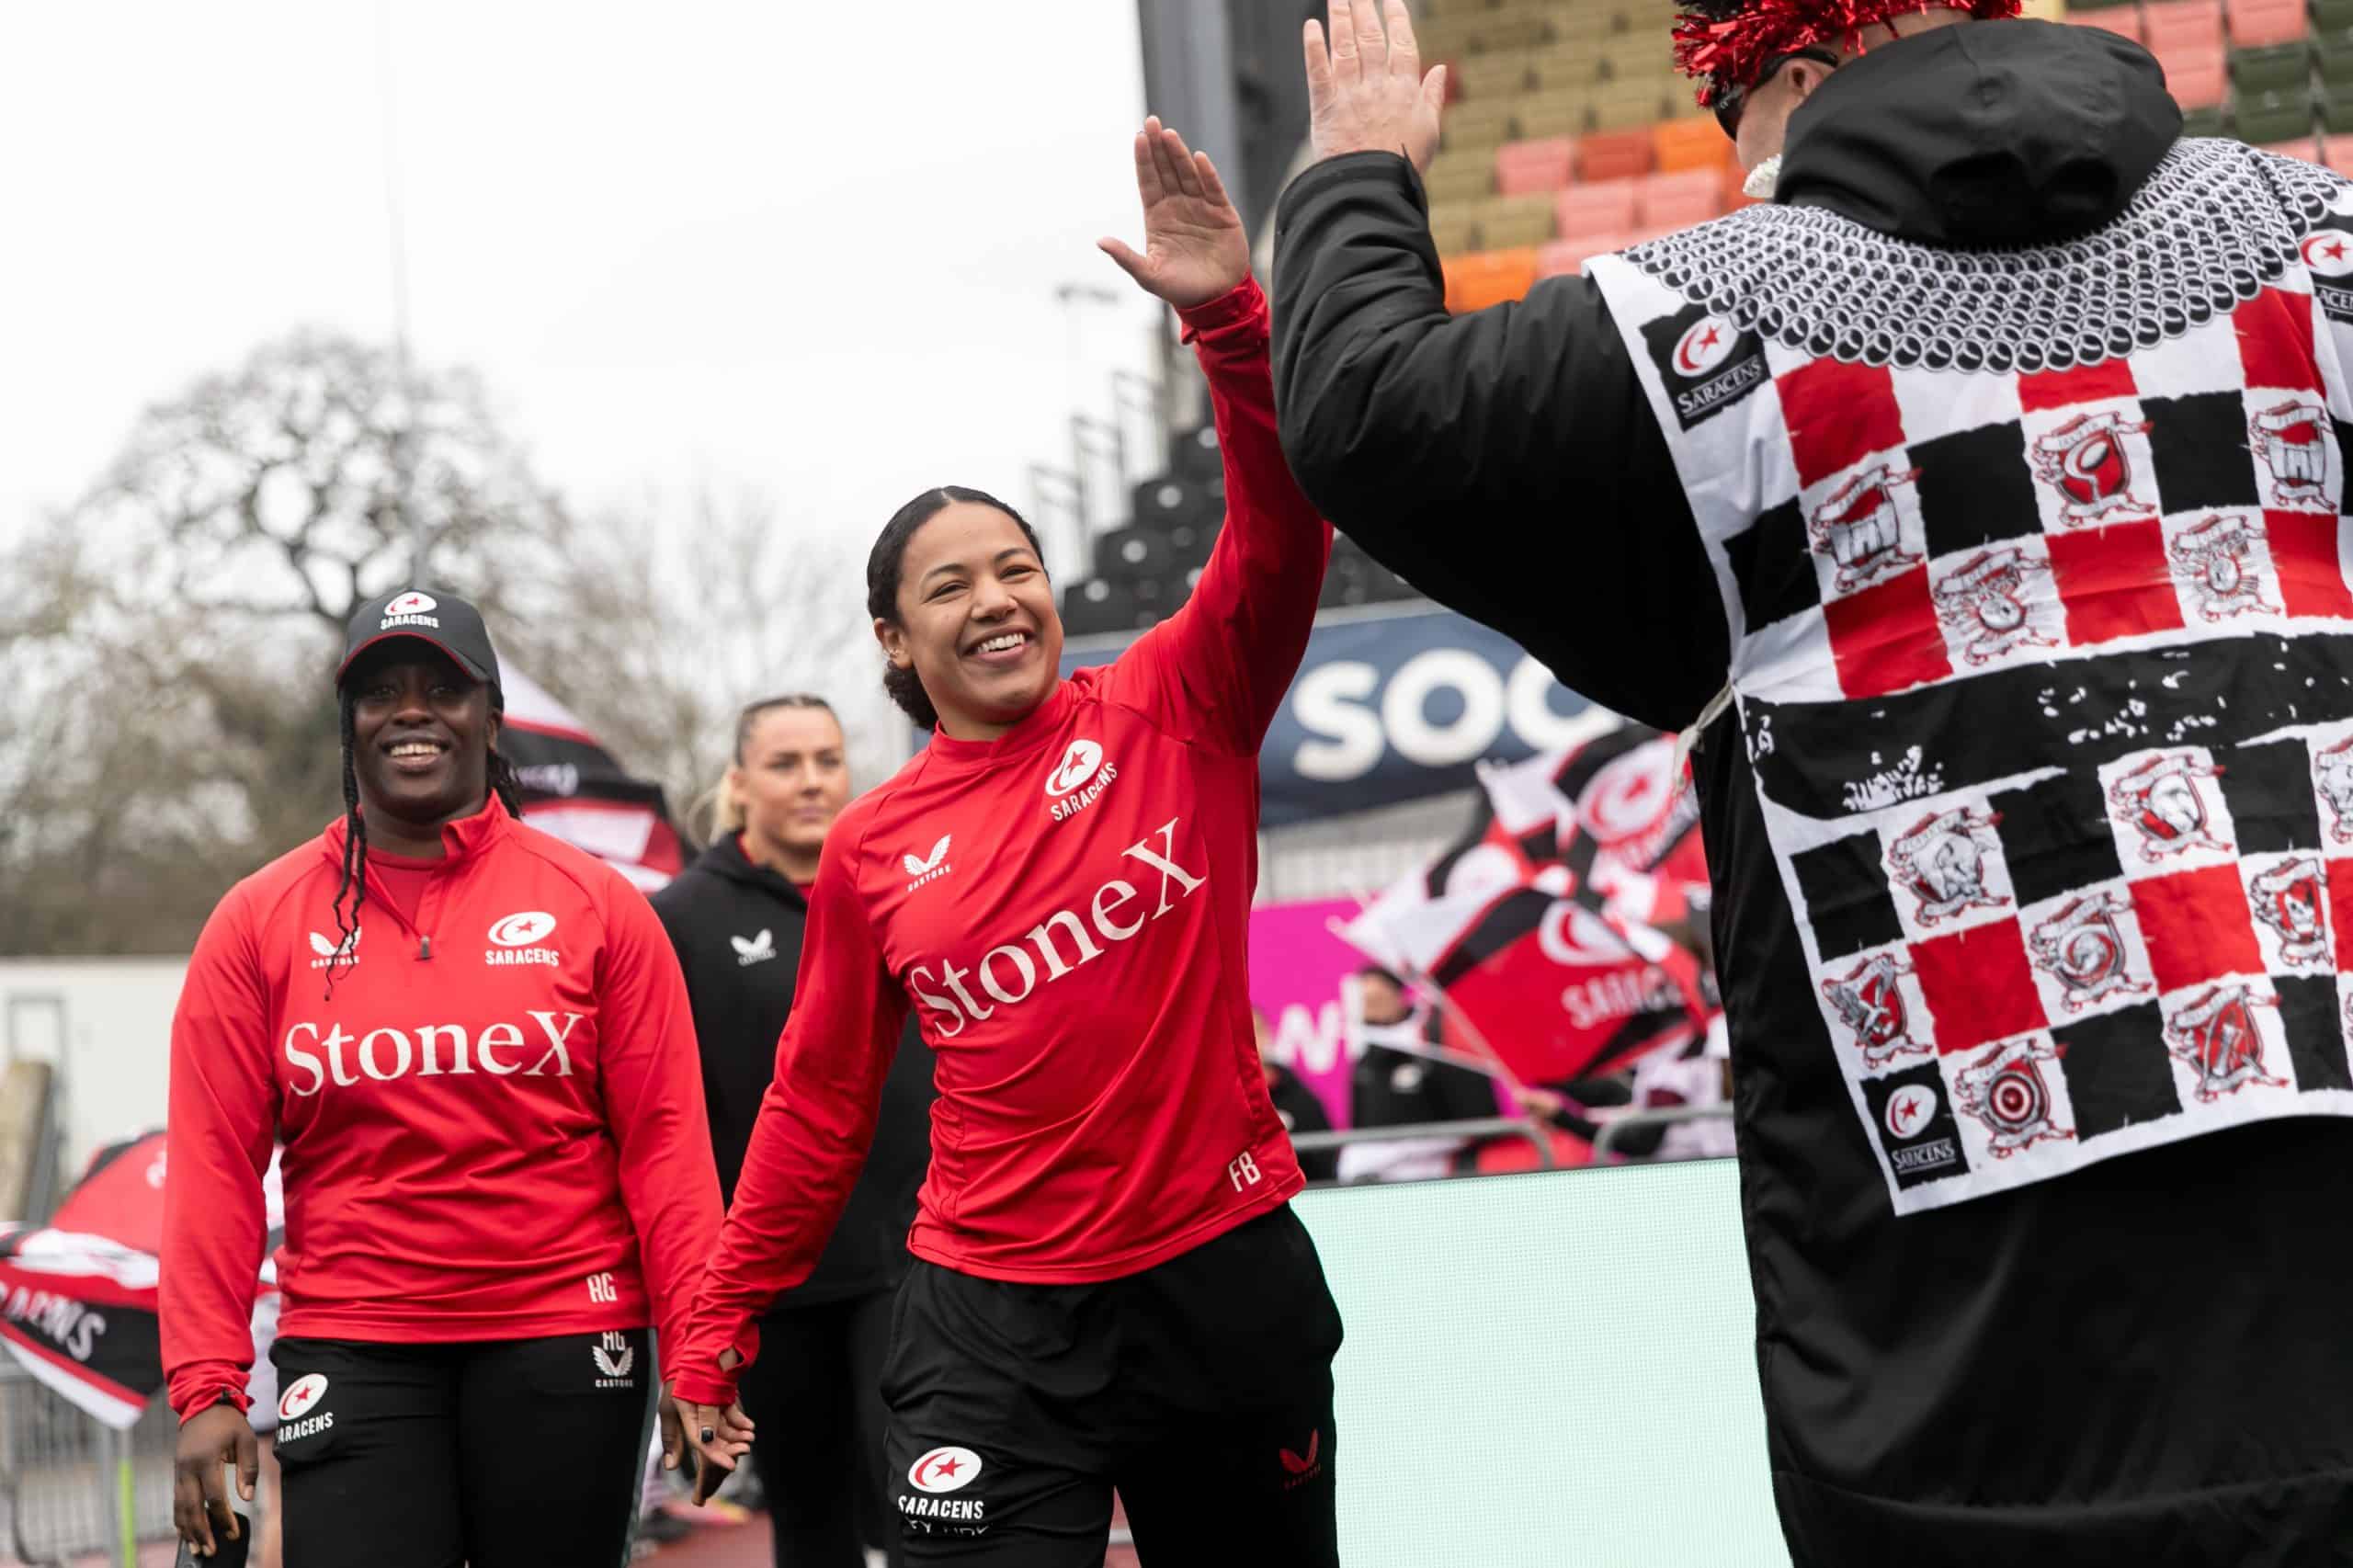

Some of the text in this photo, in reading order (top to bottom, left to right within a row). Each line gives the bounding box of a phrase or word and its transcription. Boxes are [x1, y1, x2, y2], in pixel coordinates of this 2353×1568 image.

[1677, 360, 1762, 415] SARACENS
[381, 615, 438, 631] SARACENS
[1051, 762, 1118, 821] SARACENS
[911, 816, 1207, 1038] StoneX
[485, 949, 559, 966] SARACENS
[285, 1010, 585, 1096] StoneX
[1228, 1151, 1261, 1192] FB
[278, 1412, 334, 1443] ARACENS
[898, 1494, 984, 1519] SARACENS
